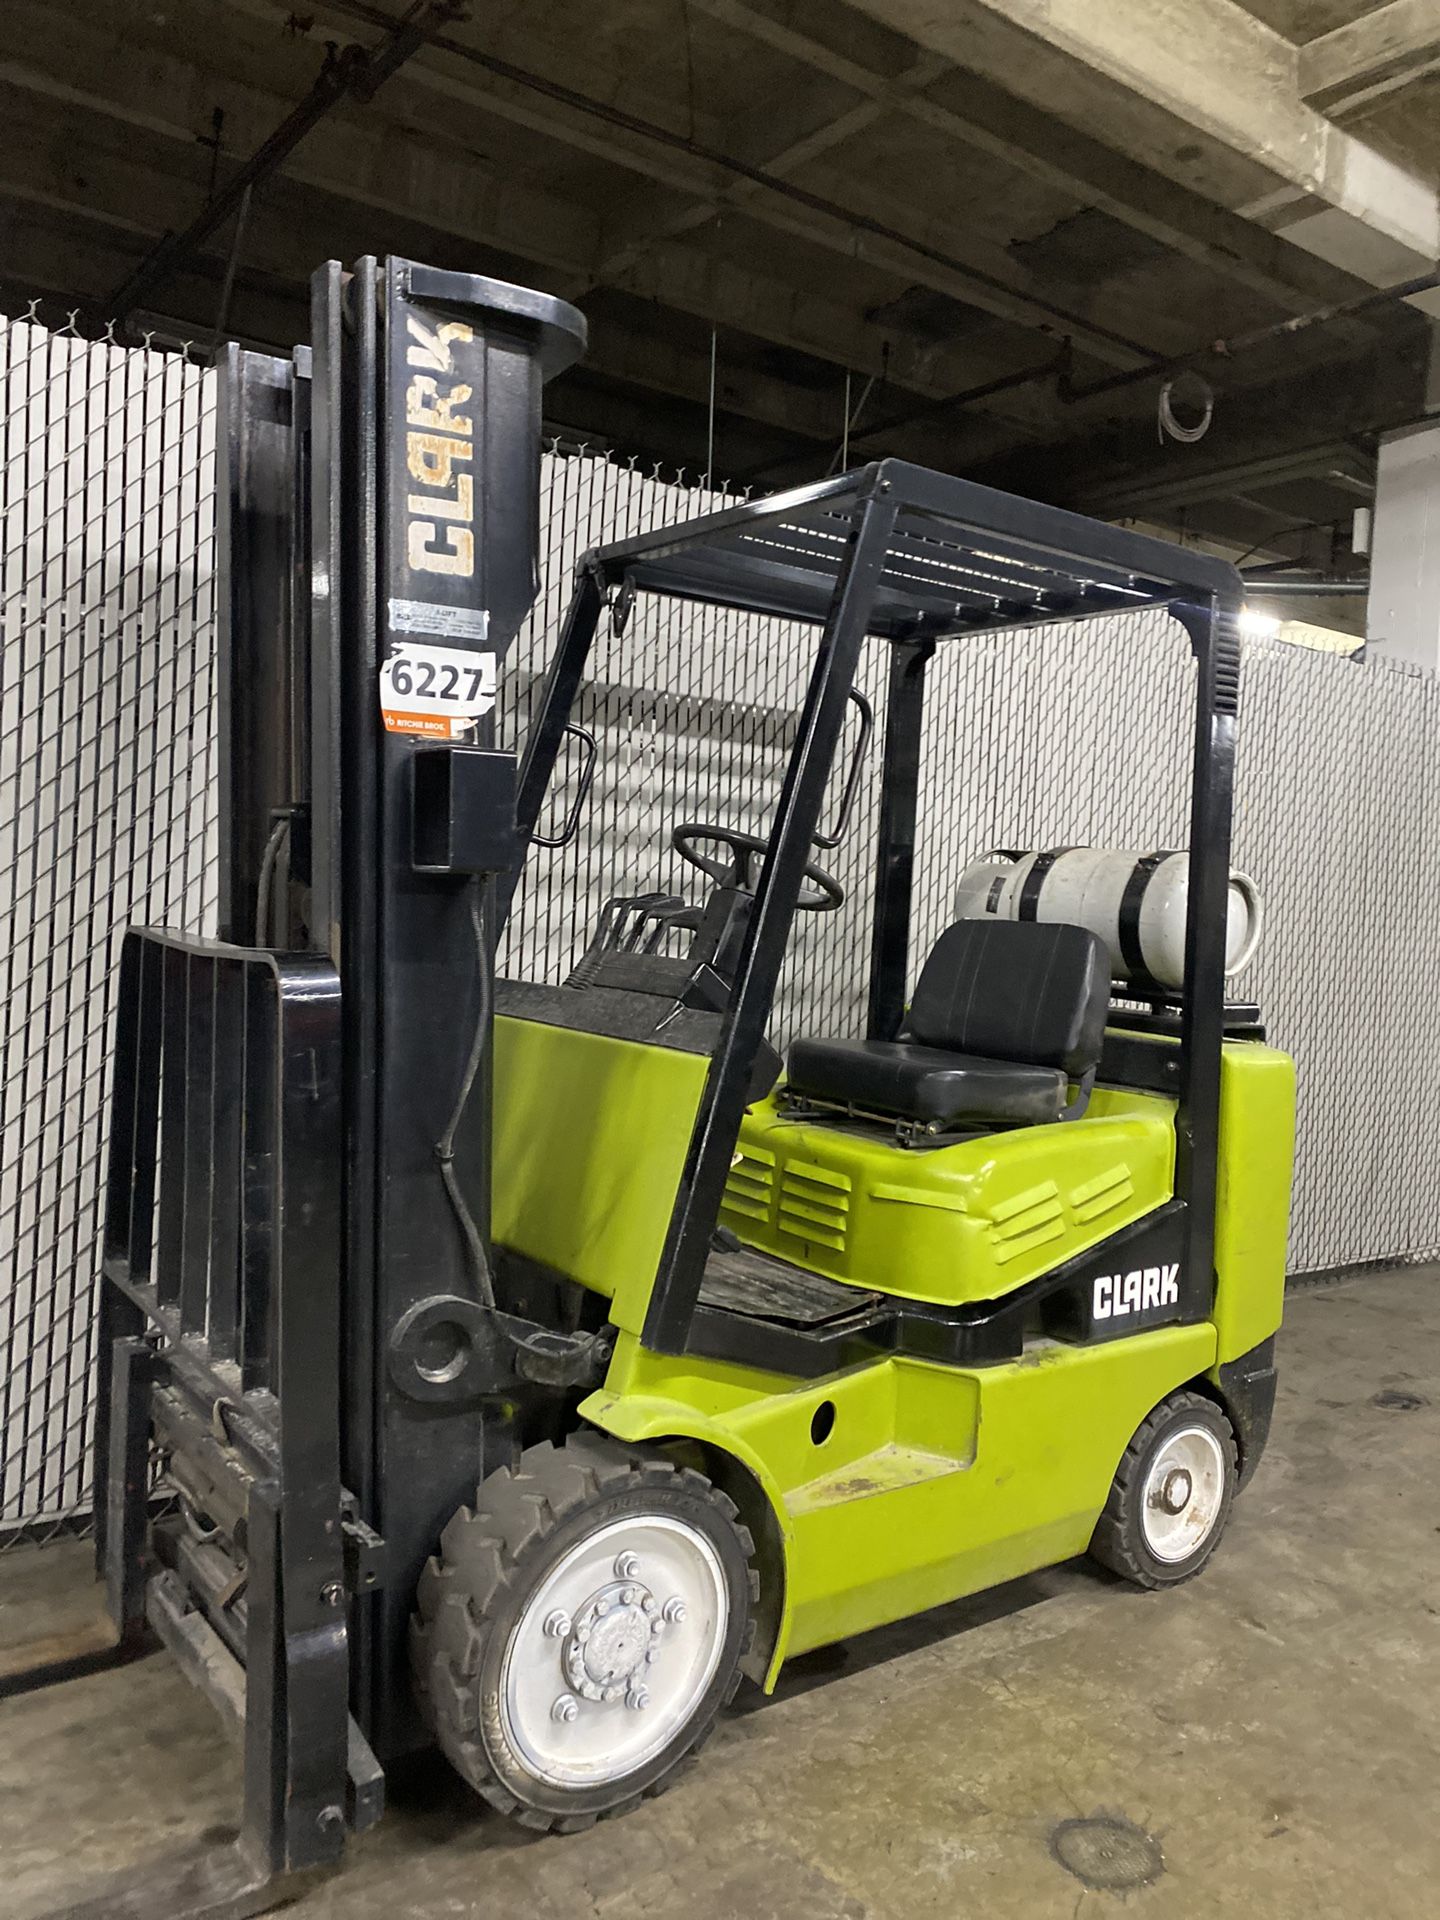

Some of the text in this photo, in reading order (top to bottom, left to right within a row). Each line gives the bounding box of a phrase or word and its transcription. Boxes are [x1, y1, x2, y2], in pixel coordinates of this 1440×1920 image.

[406, 314, 474, 577] CLARK
[391, 659, 483, 701] 6227
[1093, 1263, 1180, 1320] CLARK
